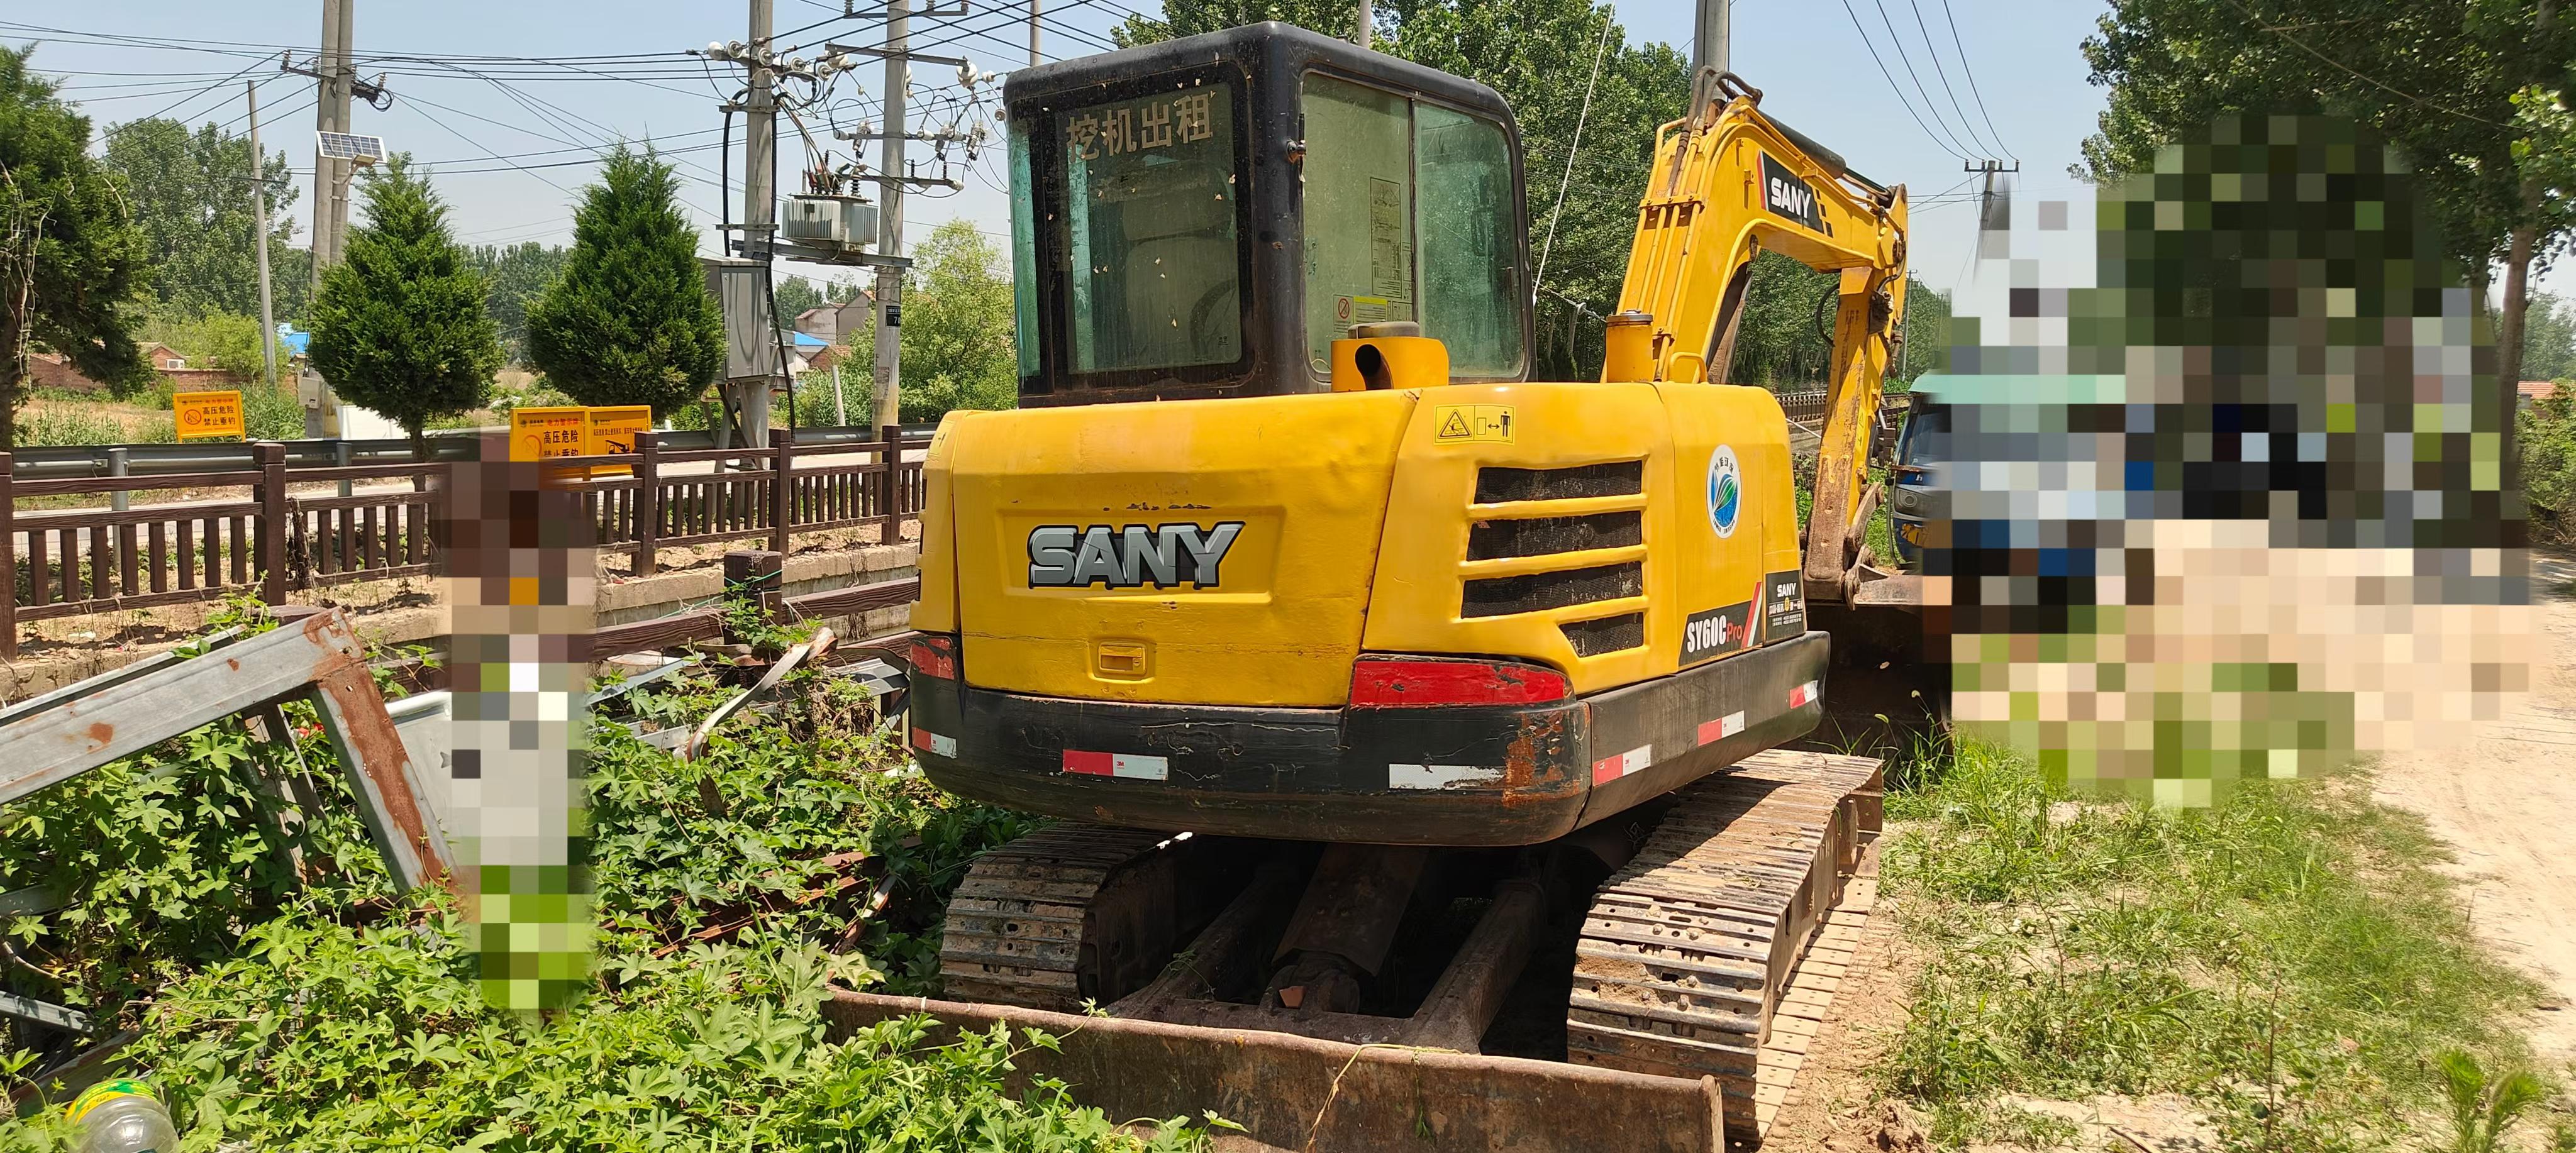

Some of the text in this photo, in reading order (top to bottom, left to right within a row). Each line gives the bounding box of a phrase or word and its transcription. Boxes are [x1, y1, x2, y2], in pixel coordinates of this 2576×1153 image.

[1066, 94, 1213, 163] 挖机出租
[1771, 177, 1811, 218] SANY
[203, 405, 234, 415] 高压危险
[204, 417, 236, 426] 禁止垂钓
[543, 429, 579, 444] 高压危险
[1028, 521, 1245, 590] SANY
[1777, 583, 1797, 597] SANY
